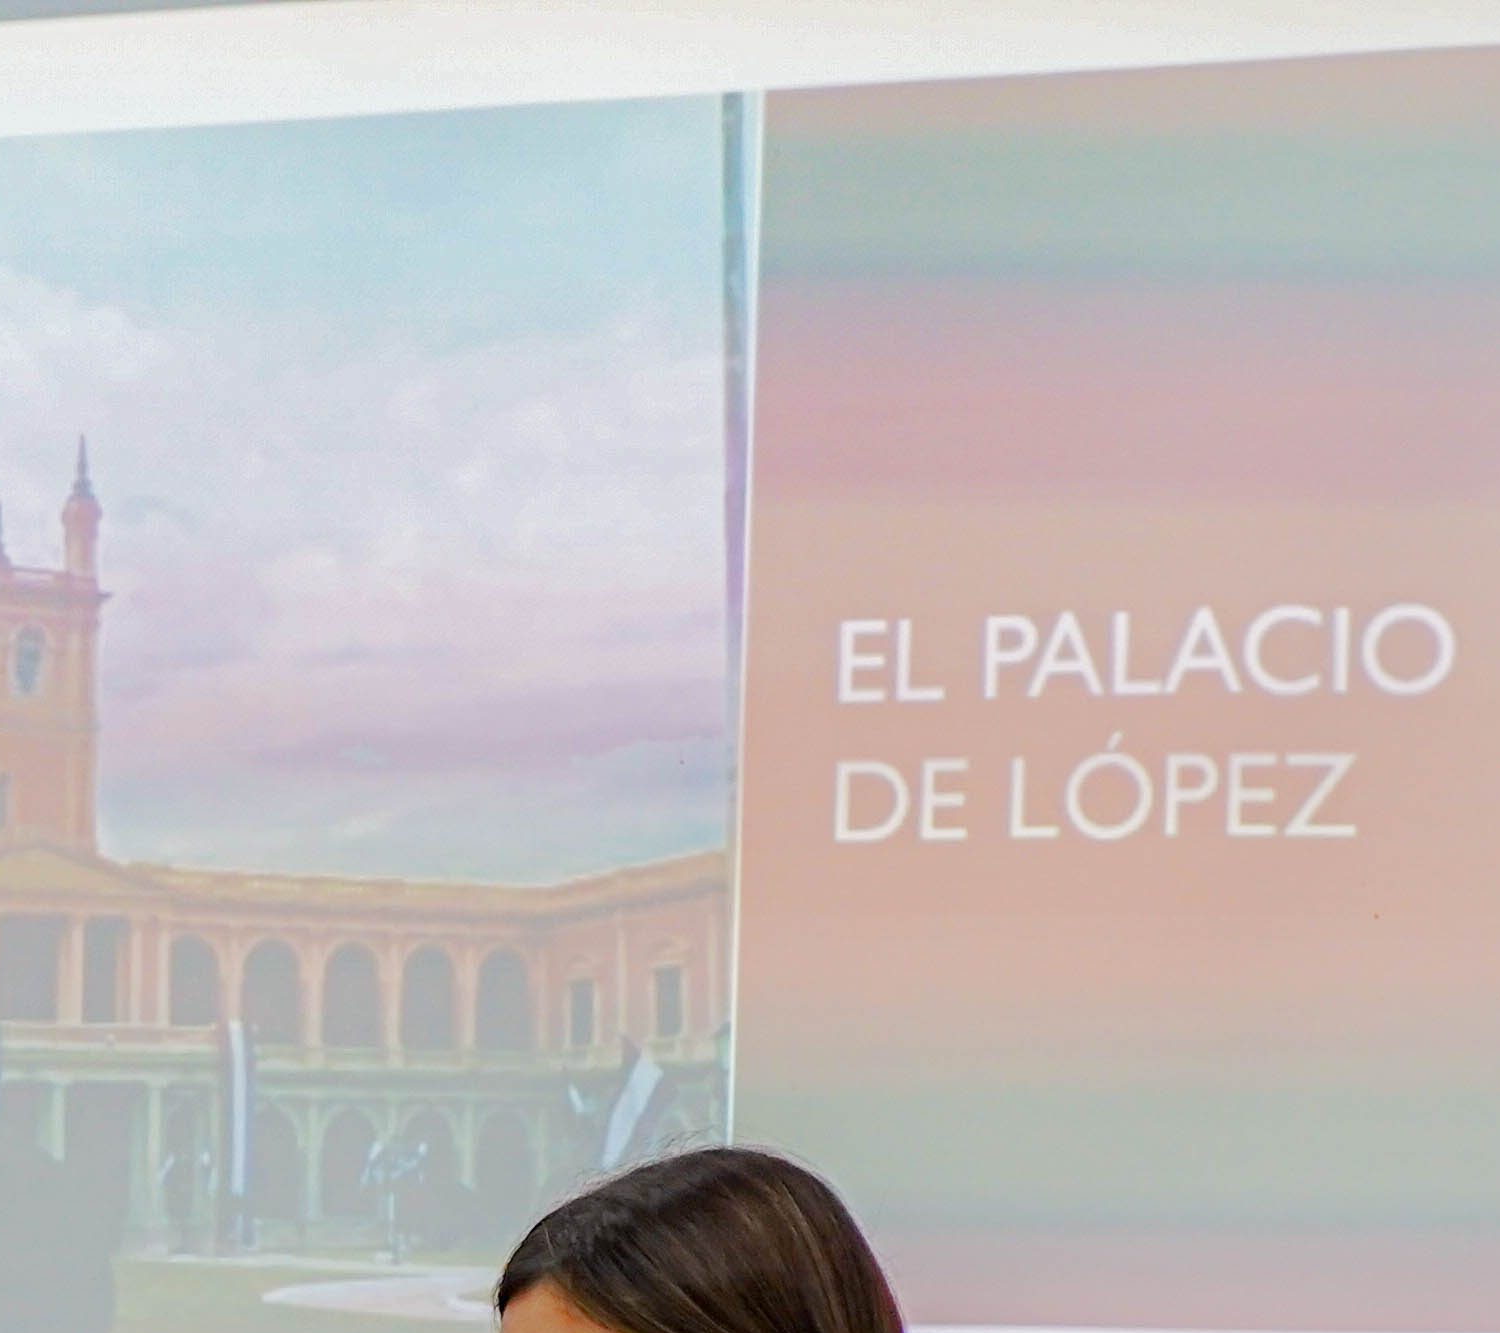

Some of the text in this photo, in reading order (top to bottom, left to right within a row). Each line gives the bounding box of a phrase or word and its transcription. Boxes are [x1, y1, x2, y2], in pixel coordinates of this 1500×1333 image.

[837, 603, 1457, 704] EL PALACIO
[833, 732, 1358, 843] DE LÓPEZ
